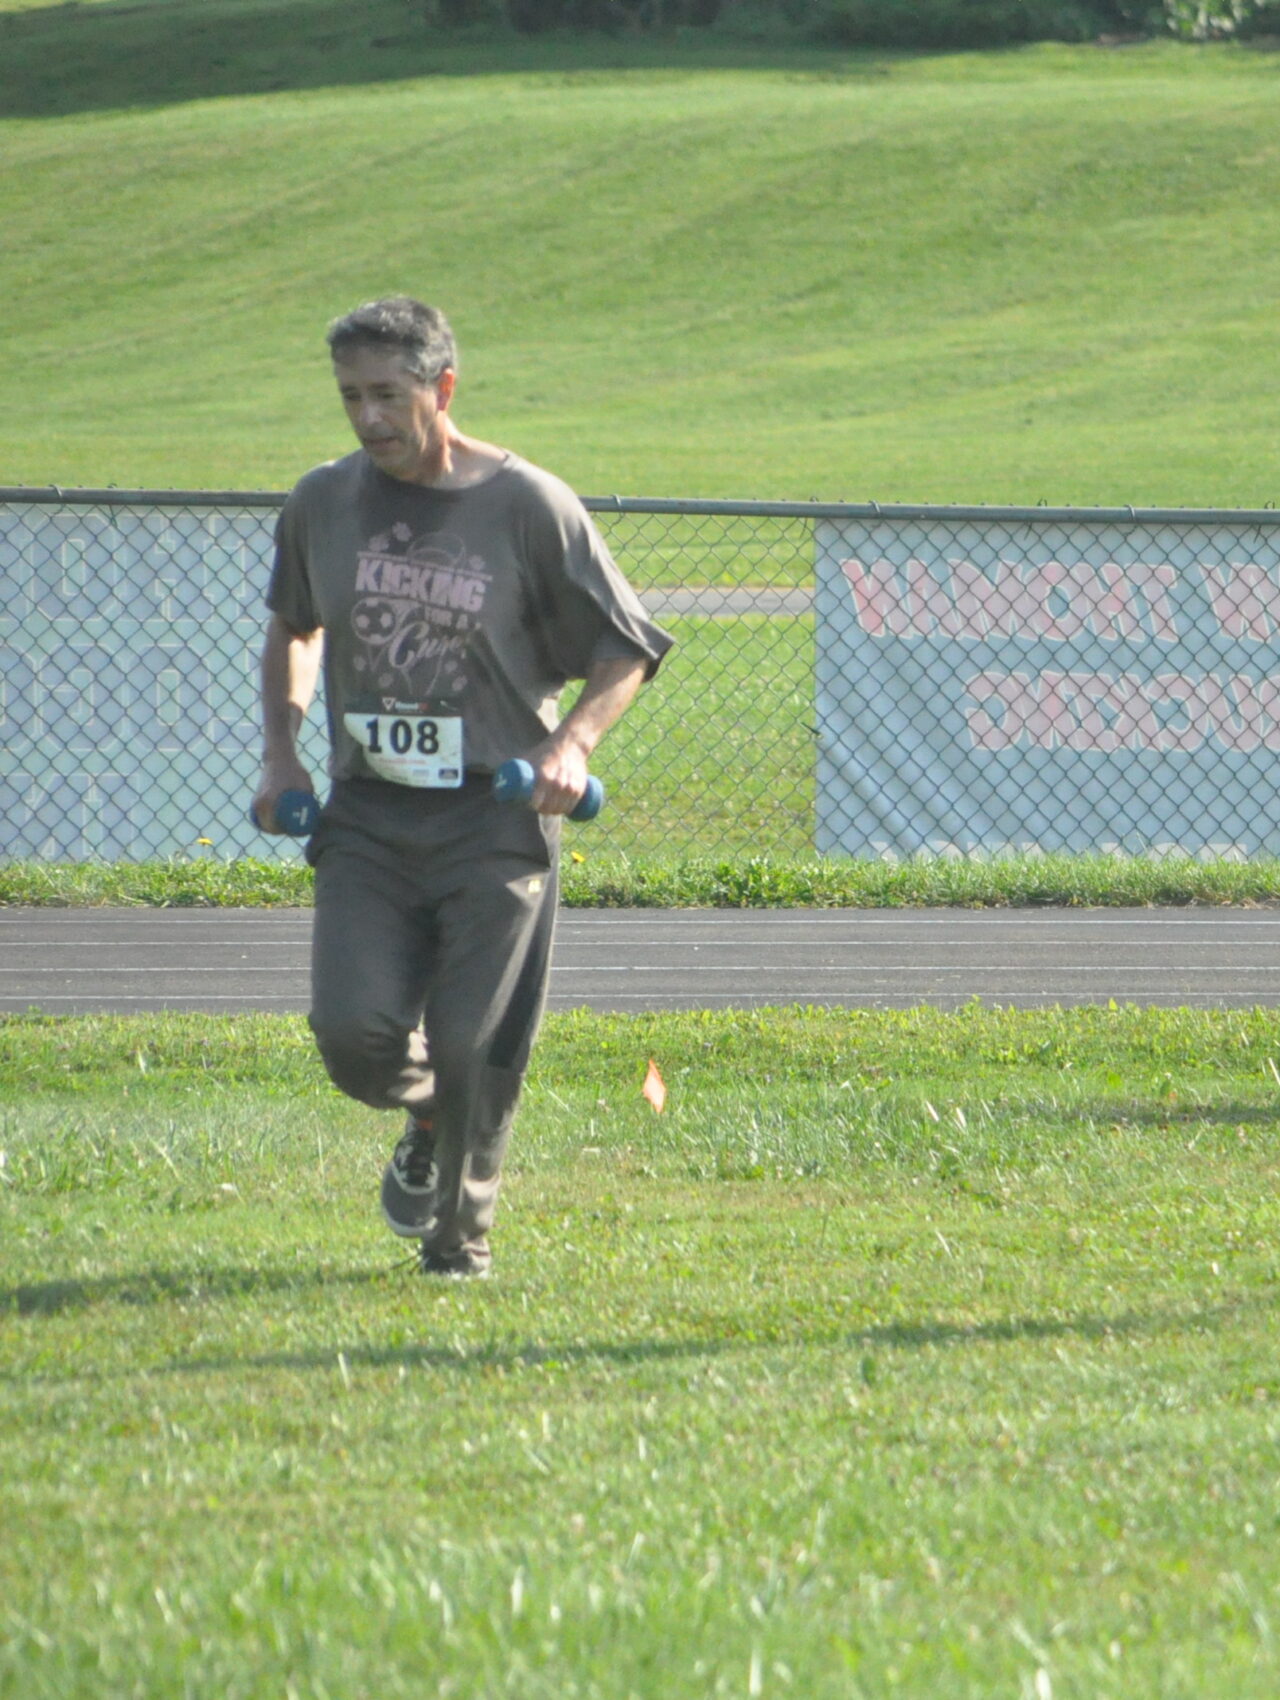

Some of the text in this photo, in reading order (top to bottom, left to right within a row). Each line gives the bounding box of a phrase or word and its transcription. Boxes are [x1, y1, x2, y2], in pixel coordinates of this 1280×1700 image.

[355, 558, 486, 613] KICKING
[455, 613, 469, 630] A
[366, 716, 440, 755] 108
